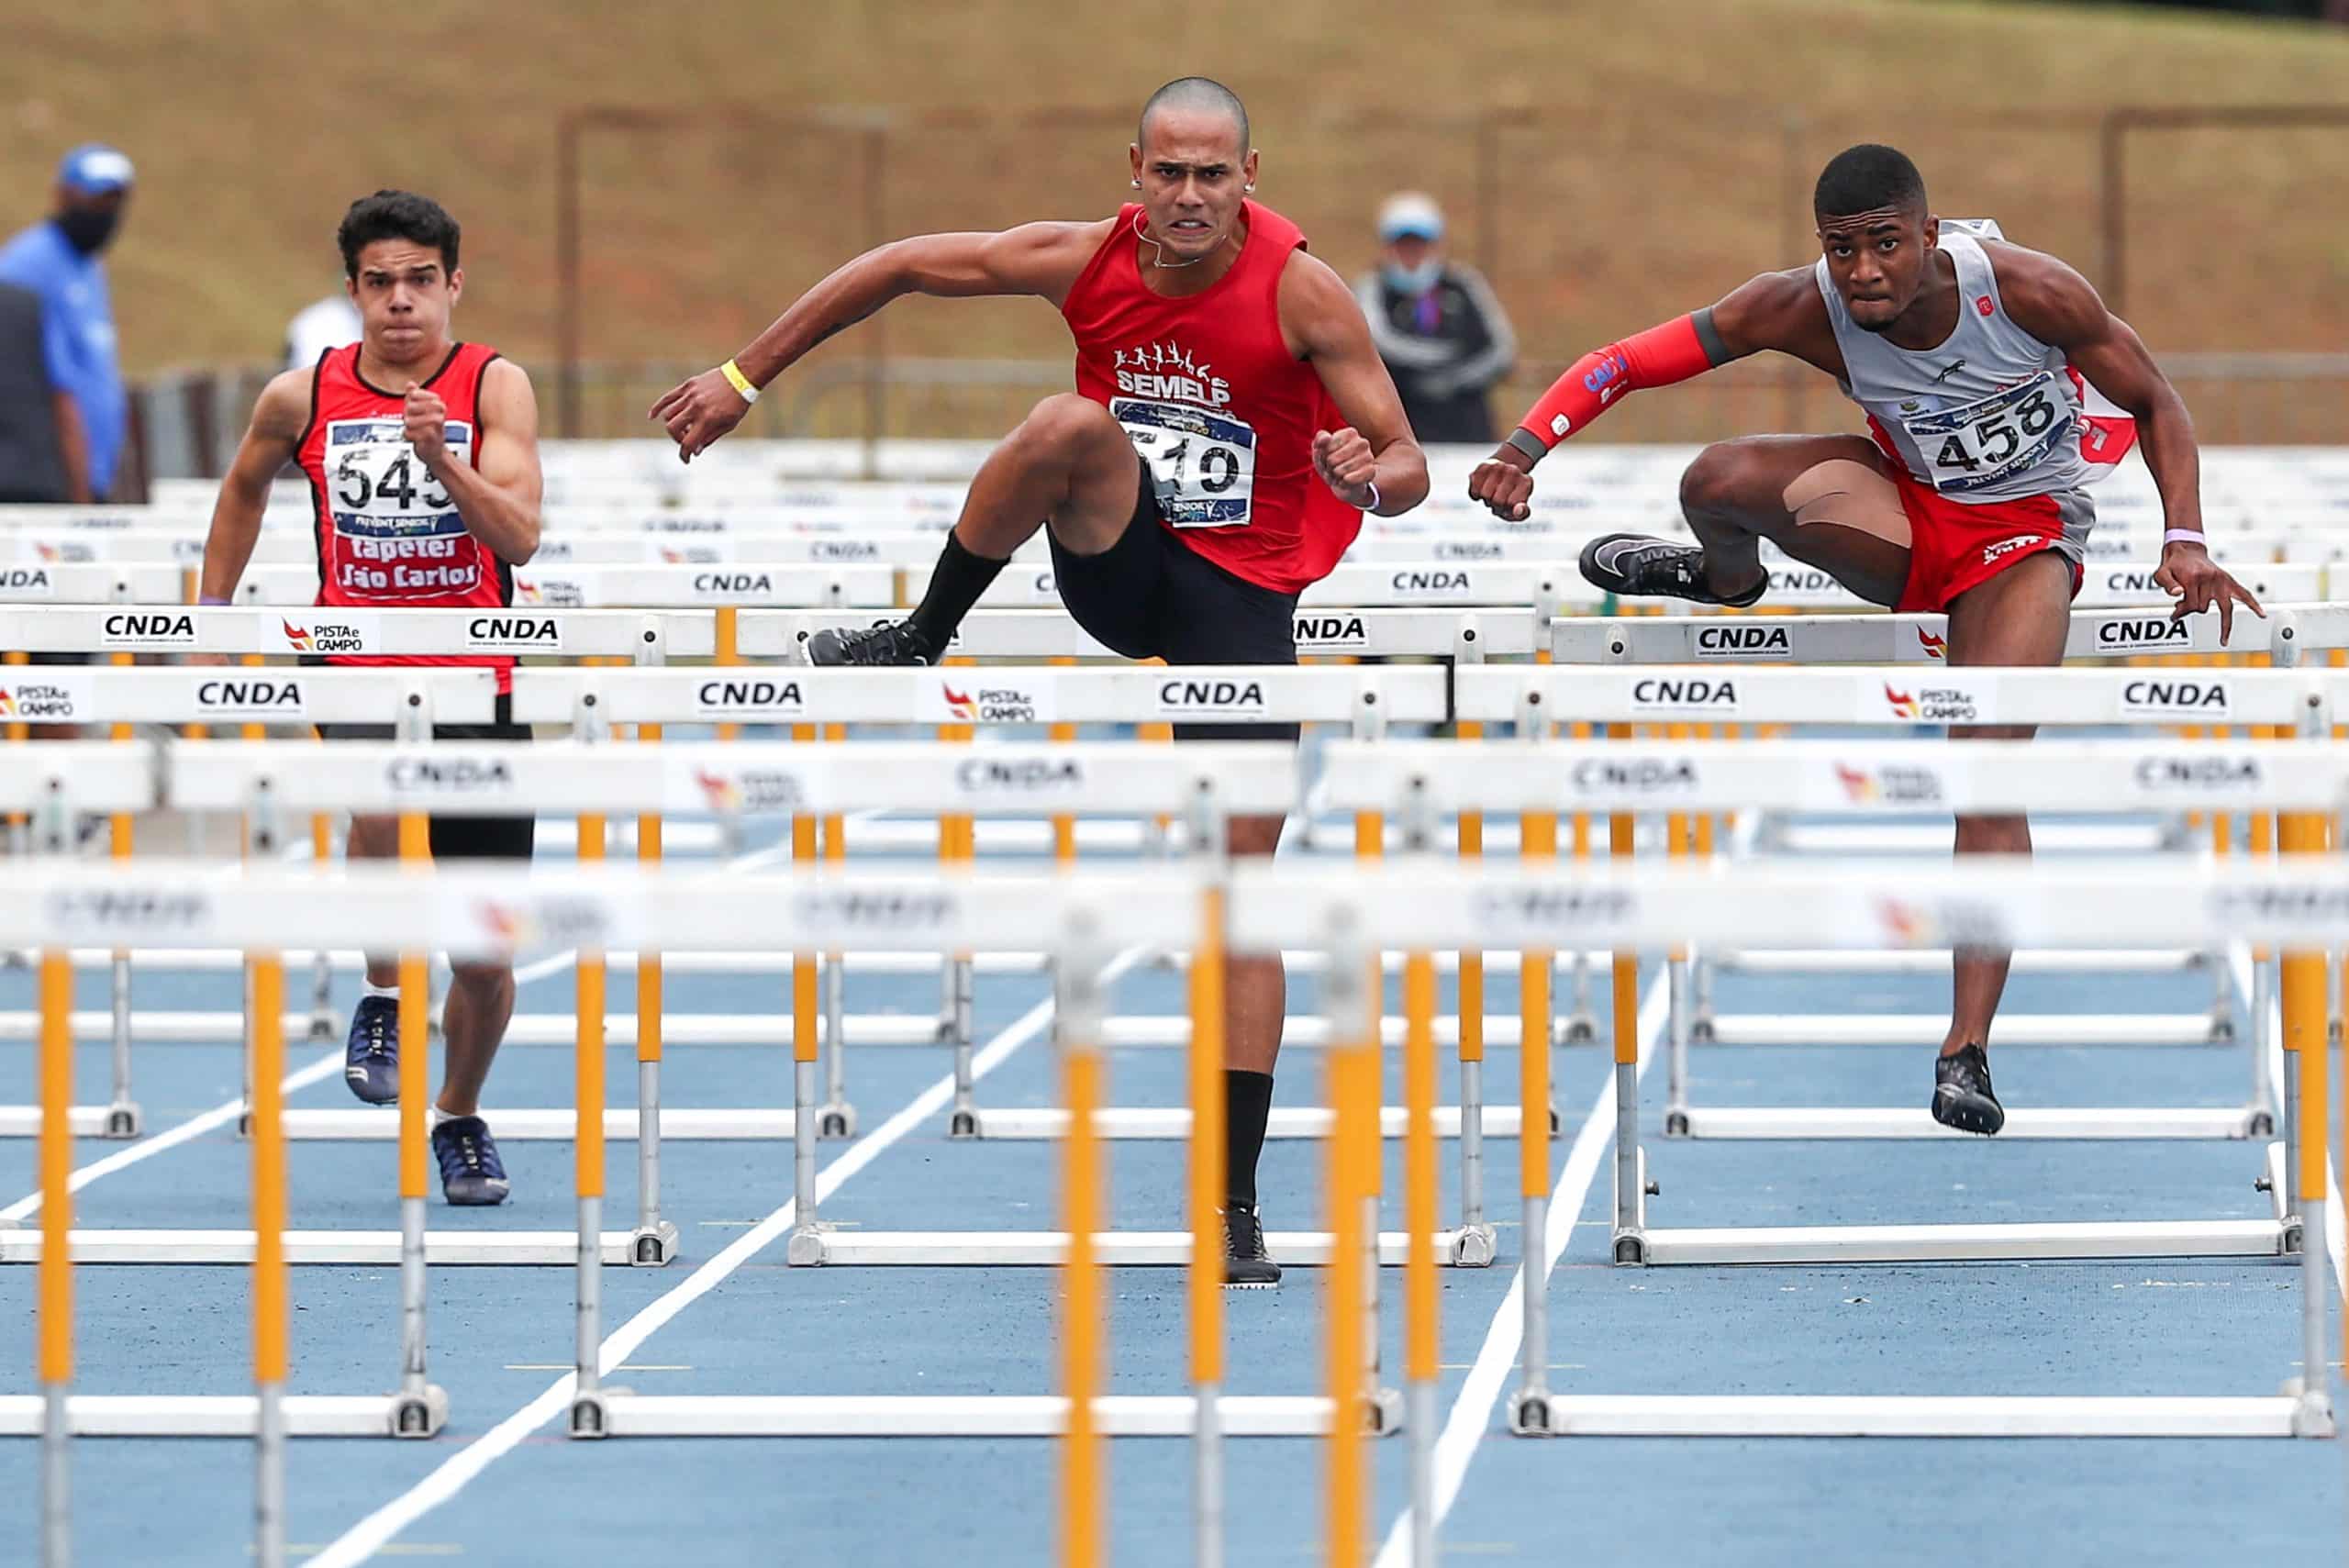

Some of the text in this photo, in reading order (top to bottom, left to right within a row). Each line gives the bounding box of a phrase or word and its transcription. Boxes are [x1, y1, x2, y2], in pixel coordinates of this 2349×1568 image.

[1936, 390, 2054, 472] 458
[694, 573, 771, 593] CNDA
[1392, 572, 1470, 590] CNDA
[105, 615, 194, 636] CNDA
[314, 625, 360, 638] PISTA e
[469, 618, 558, 639] CNDA
[1296, 617, 1365, 639] NDA
[2099, 618, 2189, 643] CNDA
[317, 639, 362, 651] CAMPO
[1698, 628, 1788, 648] CNDA
[198, 682, 301, 706] CNDA
[699, 682, 802, 706] CNDA
[1161, 682, 1264, 706] CNDA
[1634, 680, 1736, 704] CNDA
[2123, 682, 2227, 707] CNDA
